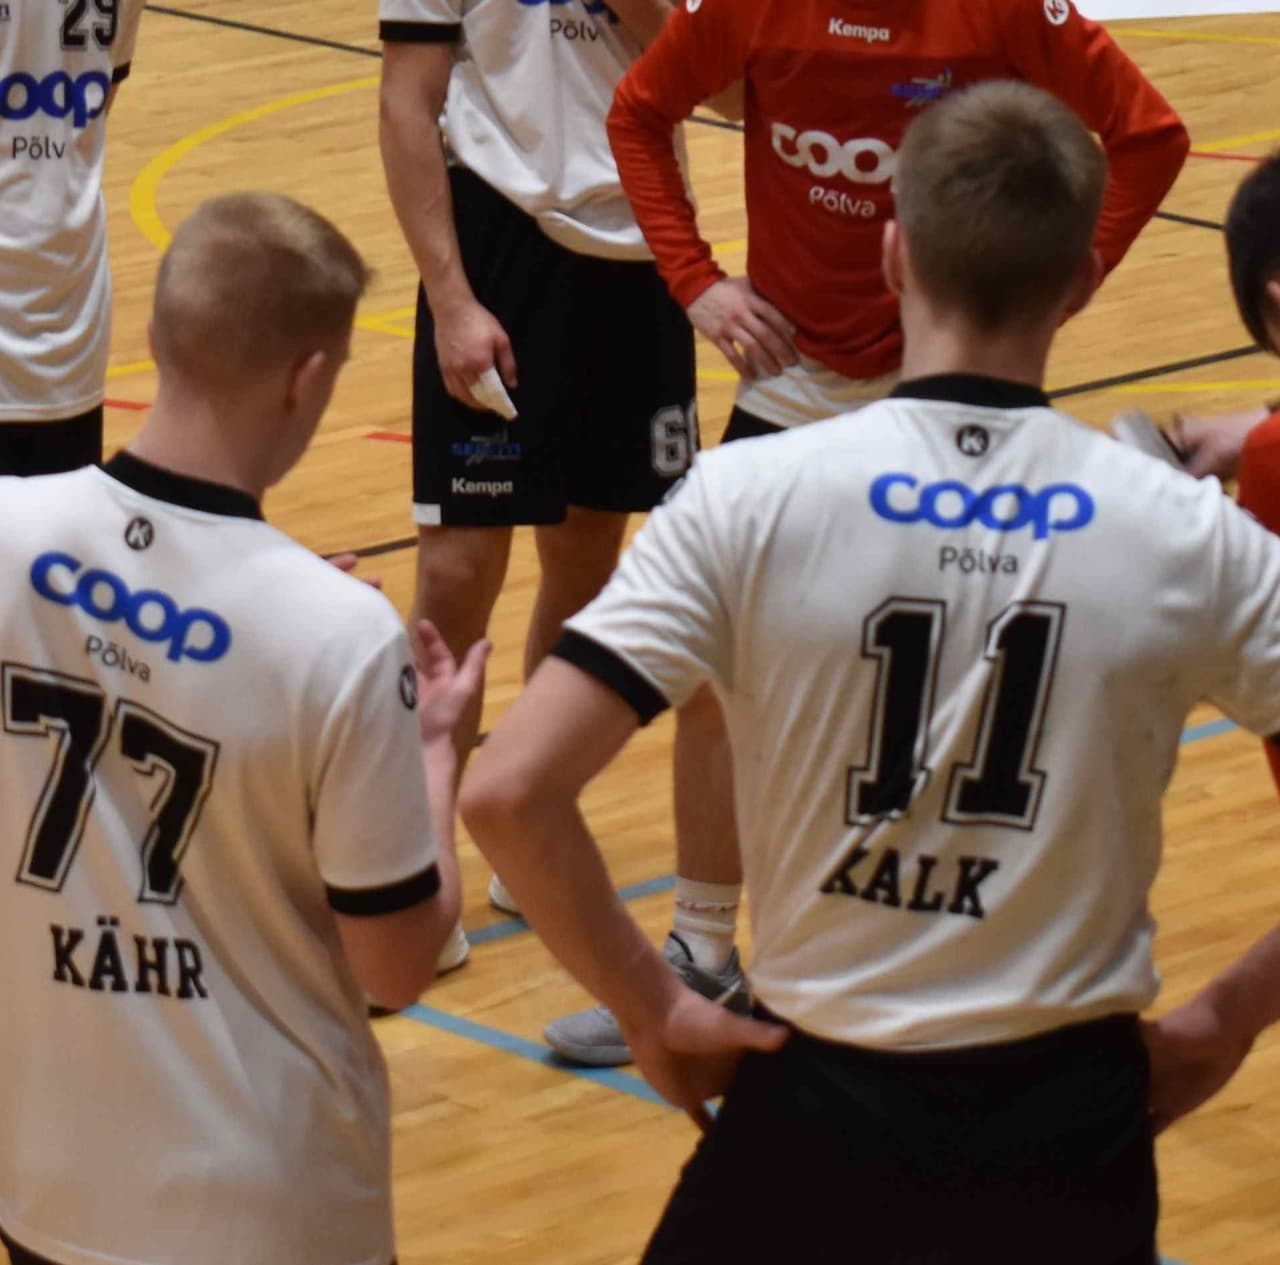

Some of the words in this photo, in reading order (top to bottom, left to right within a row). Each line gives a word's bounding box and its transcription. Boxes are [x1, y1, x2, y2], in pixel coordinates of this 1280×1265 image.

[550, 18, 602, 43] Põlv
[828, 17, 890, 43] Kempa
[11, 135, 66, 161] Põlv
[770, 121, 898, 194] coo
[809, 185, 877, 218] Põlva
[451, 476, 514, 498] Kempa
[868, 471, 1096, 541] coop
[938, 545, 1020, 576] Põlva
[28, 550, 233, 664] coop
[85, 633, 152, 684] Põlva
[844, 595, 1068, 832] 11
[0, 660, 221, 906] 77
[818, 842, 1001, 920] KALK
[49, 916, 210, 1000] KÄHR
